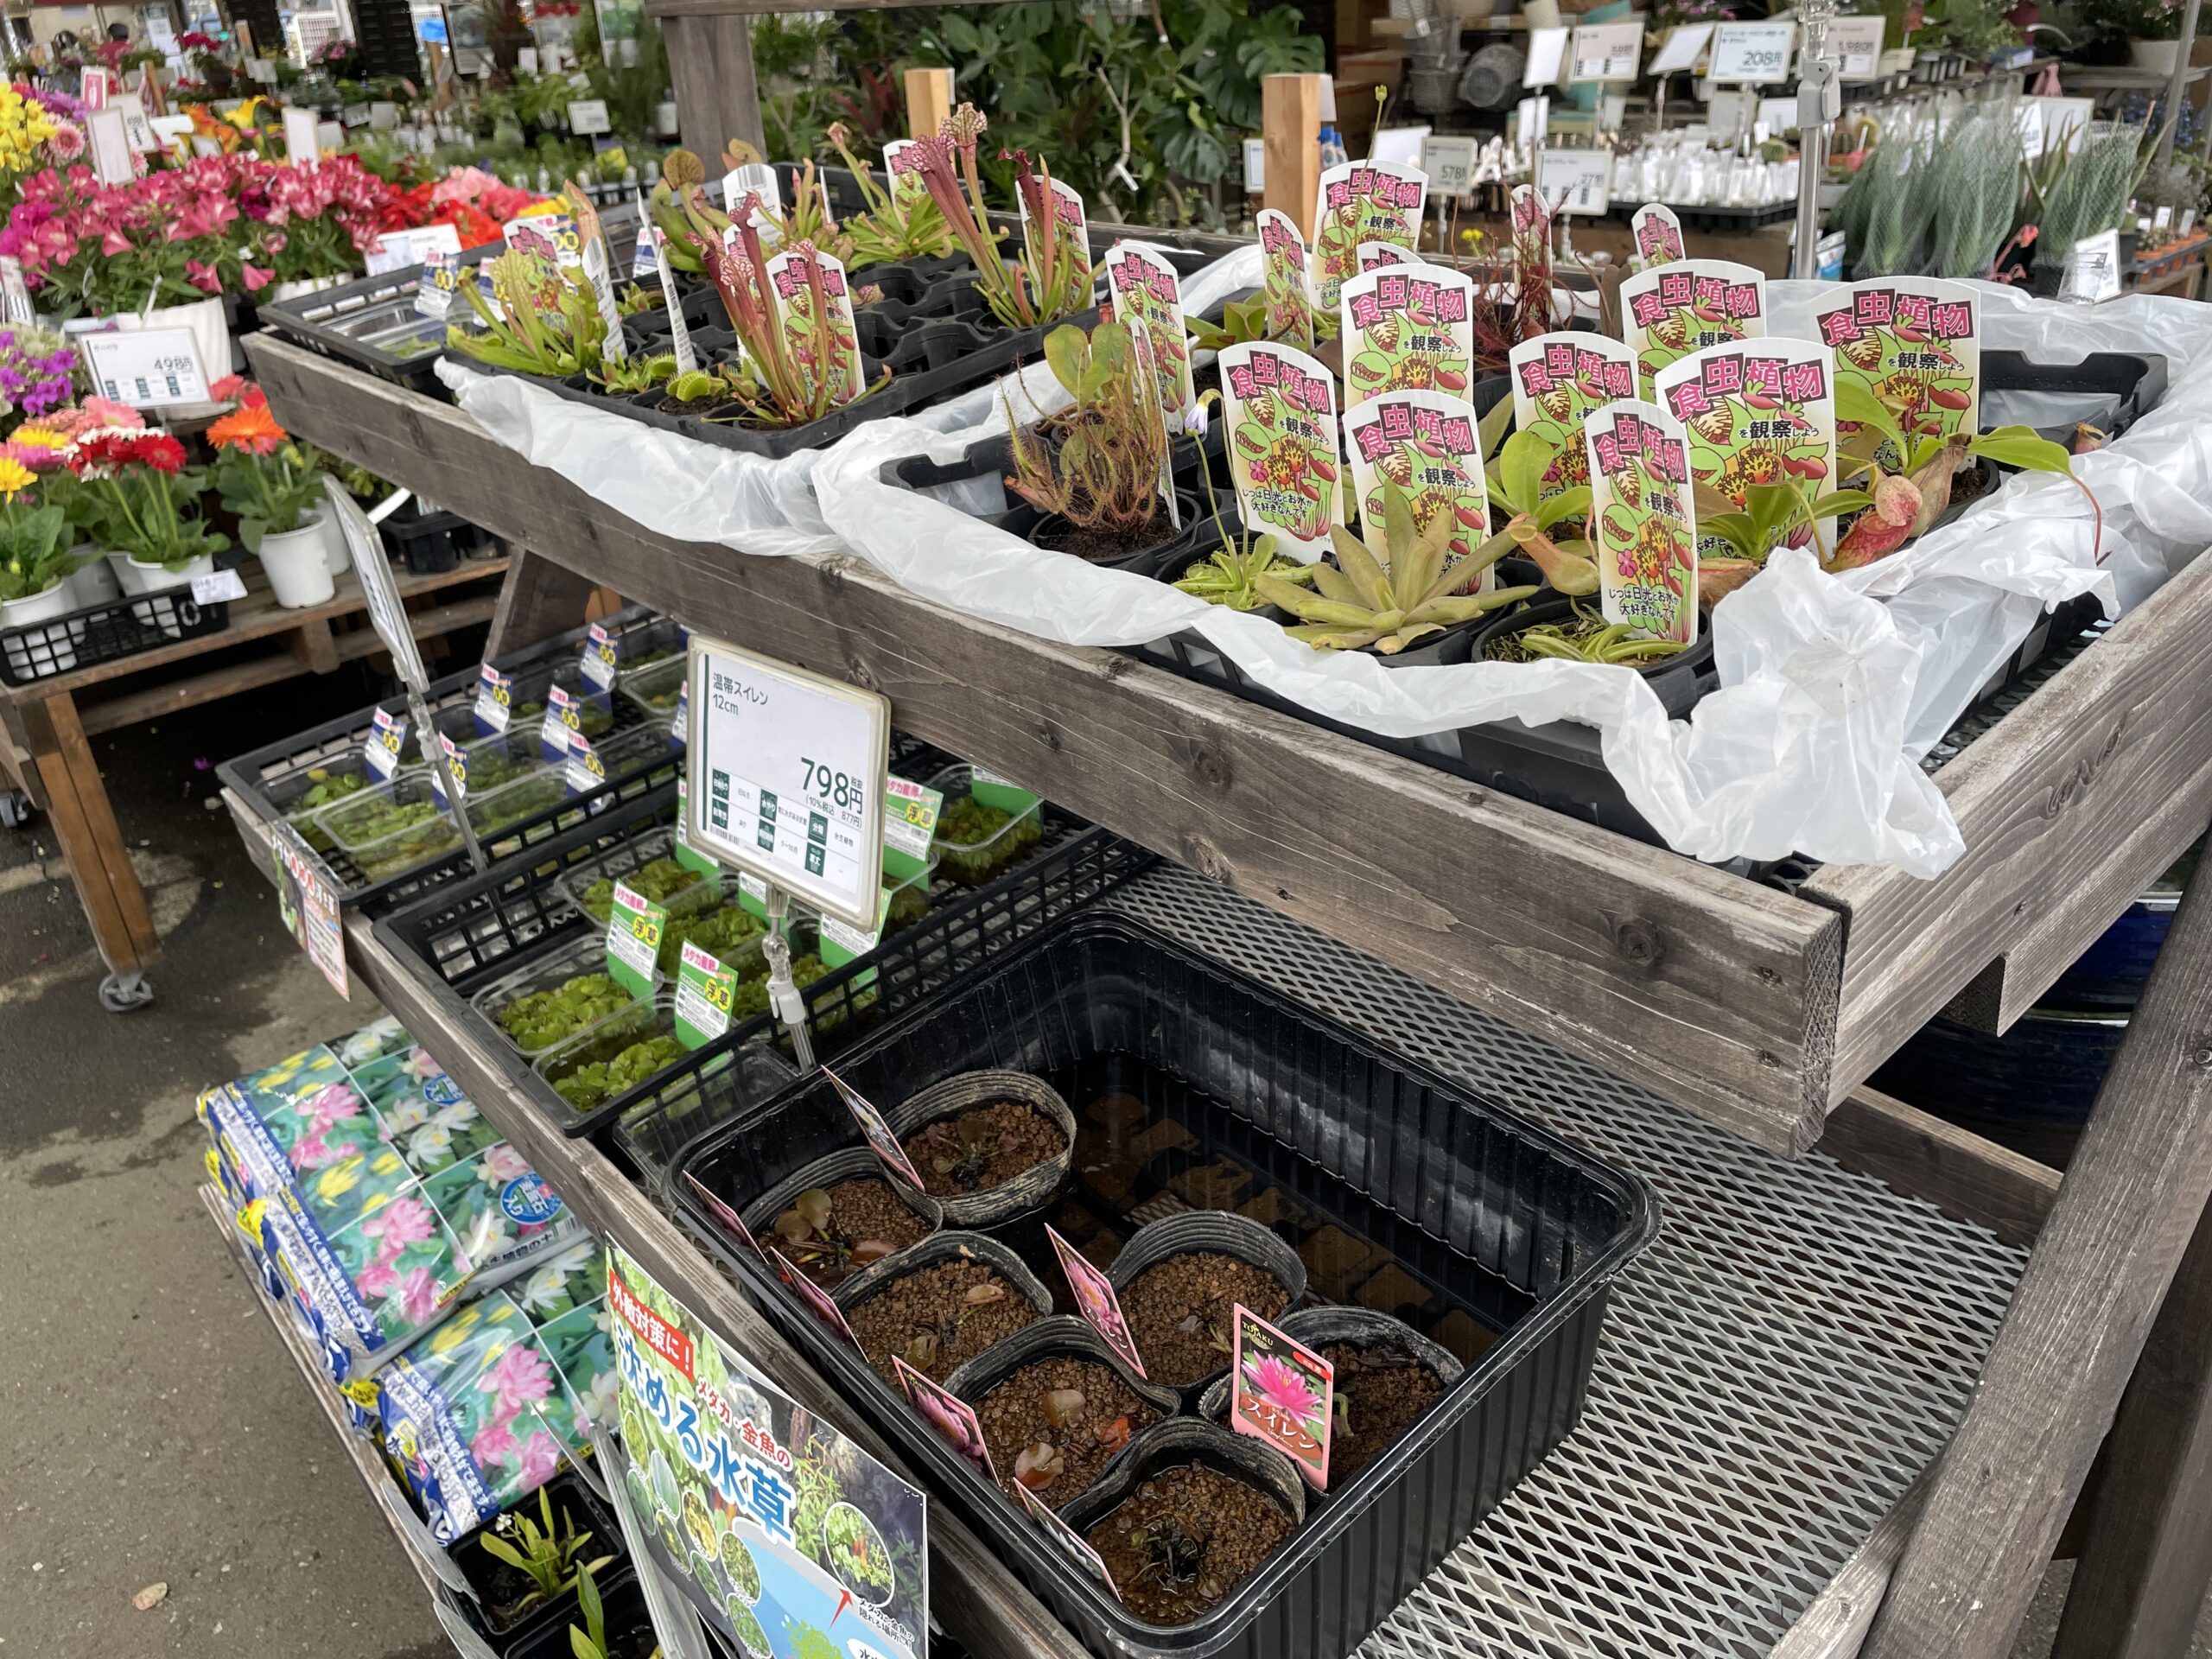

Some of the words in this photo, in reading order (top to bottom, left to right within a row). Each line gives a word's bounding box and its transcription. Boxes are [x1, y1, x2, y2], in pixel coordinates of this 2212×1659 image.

[1326, 168, 1422, 210] 食虫植物
[773, 257, 846, 299] 食虫物
[1110, 251, 1179, 304] 食虫植物
[1349, 274, 1468, 330] 食虫植物
[1629, 271, 1761, 329] 食虫植物
[1816, 288, 1974, 348] 食虫植物
[1403, 334, 1462, 354] を観察しよう
[1887, 351, 1965, 372] を観察しよう
[1226, 350, 1332, 416] 食虫植物
[1518, 343, 1635, 398] 食虫植物
[1664, 353, 1827, 423] 食虫植物
[1279, 416, 1330, 445] を観察しよう
[1352, 402, 1477, 464] 食虫植物
[1593, 412, 1688, 485] 食虫植物
[1739, 419, 1820, 440] を観察しよう
[1418, 467, 1477, 489] を観察しよう
[1252, 501, 1307, 518] 大好きなんです
[1644, 490, 1688, 524] を観察しよう
[1619, 602, 1675, 620] 大好きなんです
[713, 671, 769, 706] 温帯スイレン
[713, 694, 739, 716] 12cm
[614, 1318, 797, 1549] 沈める水草
[1247, 1397, 1316, 1449] スイレン
